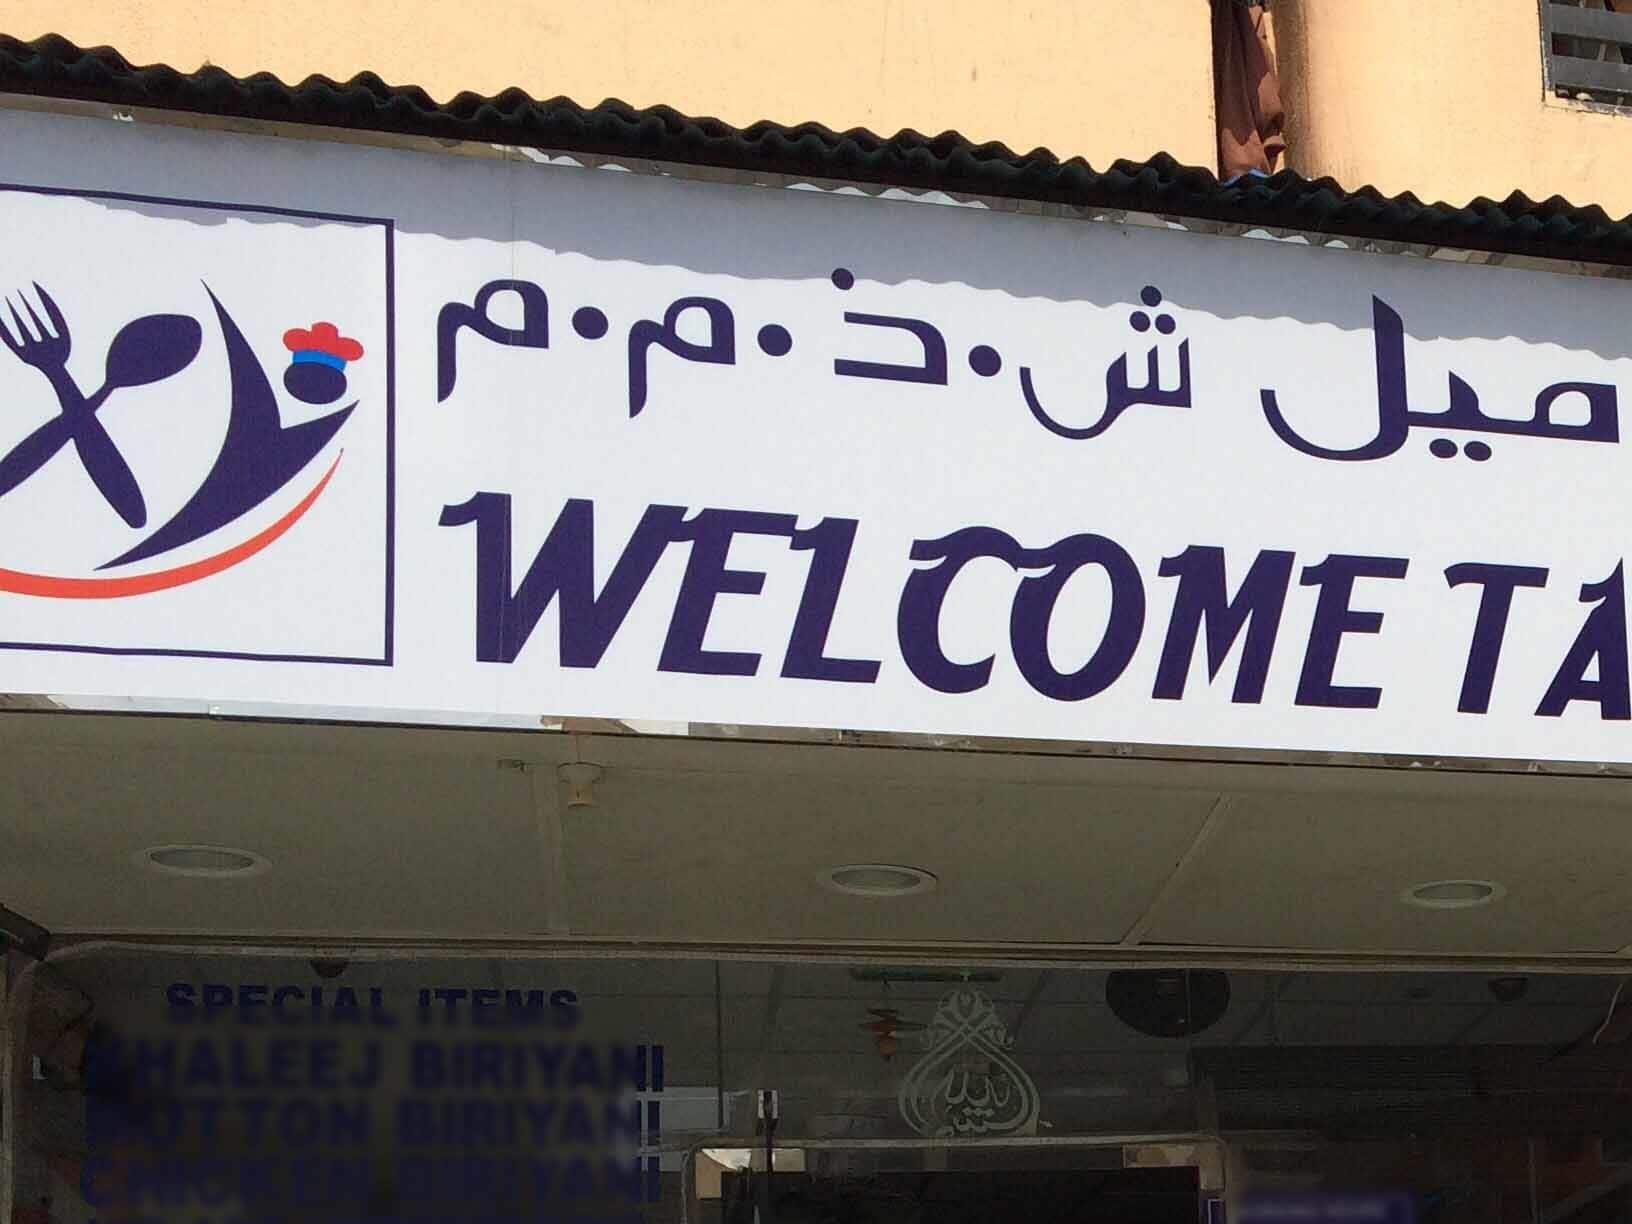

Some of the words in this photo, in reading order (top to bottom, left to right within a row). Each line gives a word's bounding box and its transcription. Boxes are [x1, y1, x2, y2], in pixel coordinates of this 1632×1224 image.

[438, 491, 1410, 709] WELCOME
[165, 981, 396, 1029] SPECIAL
[418, 987, 582, 1030] ITEMS
